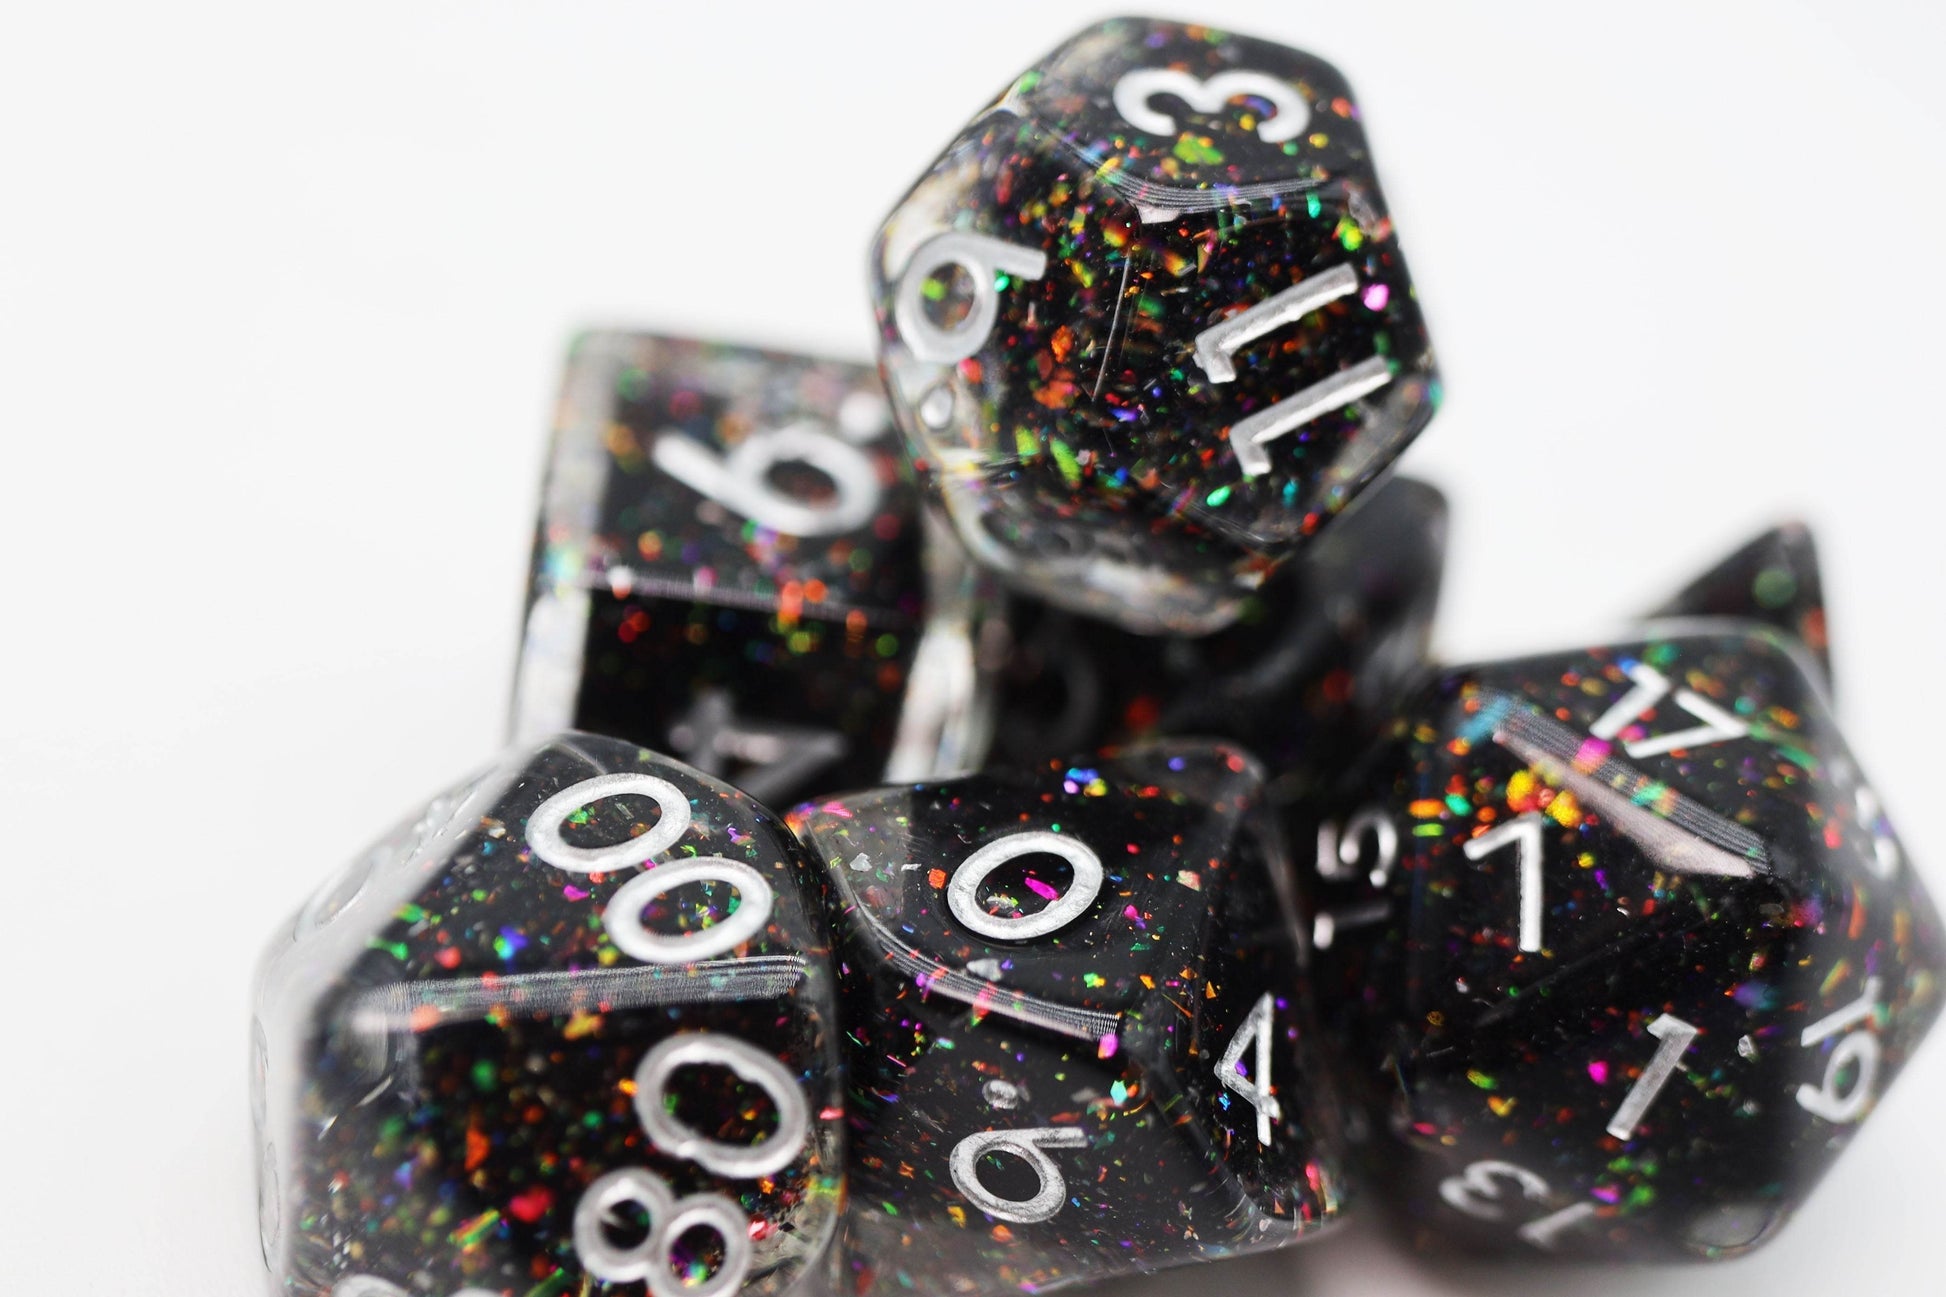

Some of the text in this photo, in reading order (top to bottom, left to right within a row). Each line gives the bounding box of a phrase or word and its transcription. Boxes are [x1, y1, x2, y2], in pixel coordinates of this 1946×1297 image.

[1113, 68, 1311, 143] 3
[1193, 261, 1393, 477] 11
[1588, 663, 1748, 759] 17
[1464, 812, 1543, 953] 7
[1214, 993, 1283, 1148] 4
[1607, 1012, 1699, 1142] 1
